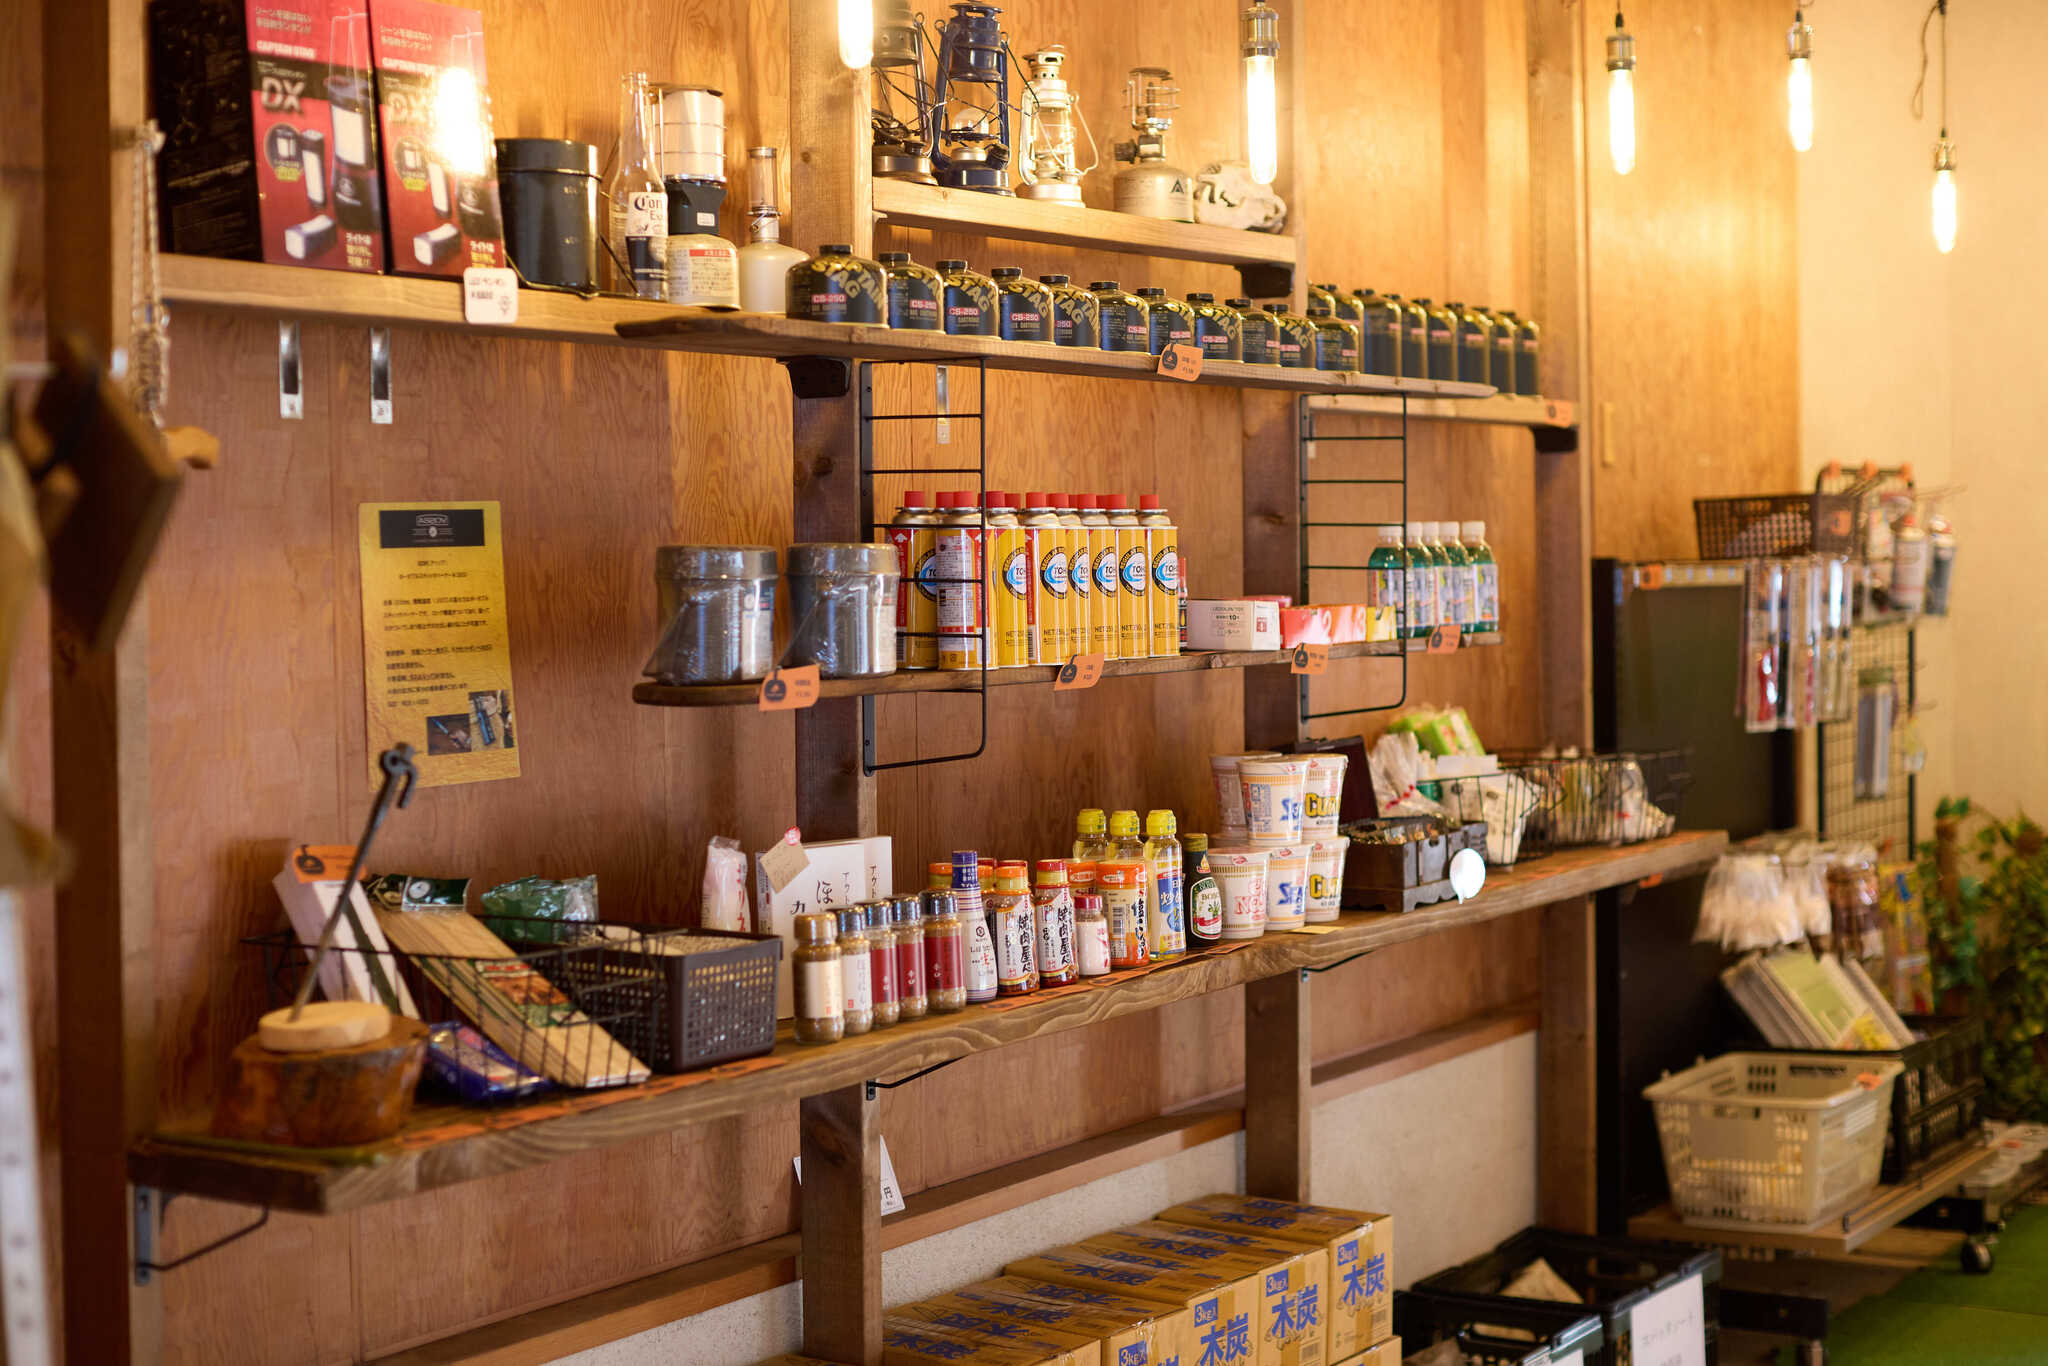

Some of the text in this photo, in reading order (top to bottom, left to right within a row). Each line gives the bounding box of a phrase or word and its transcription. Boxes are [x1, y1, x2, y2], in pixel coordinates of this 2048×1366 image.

[261, 77, 305, 112] DX
[811, 258, 861, 298] STAG
[812, 293, 847, 303] CS-250
[946, 277, 990, 312] STAG
[1007, 282, 1048, 318] STAG
[949, 306, 979, 316] CS-250
[1011, 312, 1040, 322] CS-250
[1122, 624, 1132, 632] NET
[816, 880, 833, 904] ほ
[1211, 1212, 1297, 1229] 木炭
[1140, 1238, 1228, 1259] 木炭
[1064, 1264, 1157, 1285] 木炭
[1344, 1253, 1384, 1305] 木炭
[979, 1302, 1075, 1323] 木炭
[1271, 1284, 1318, 1338] 木炭
[883, 1333, 980, 1359] 木炭
[1200, 1312, 1248, 1366] 木炭
